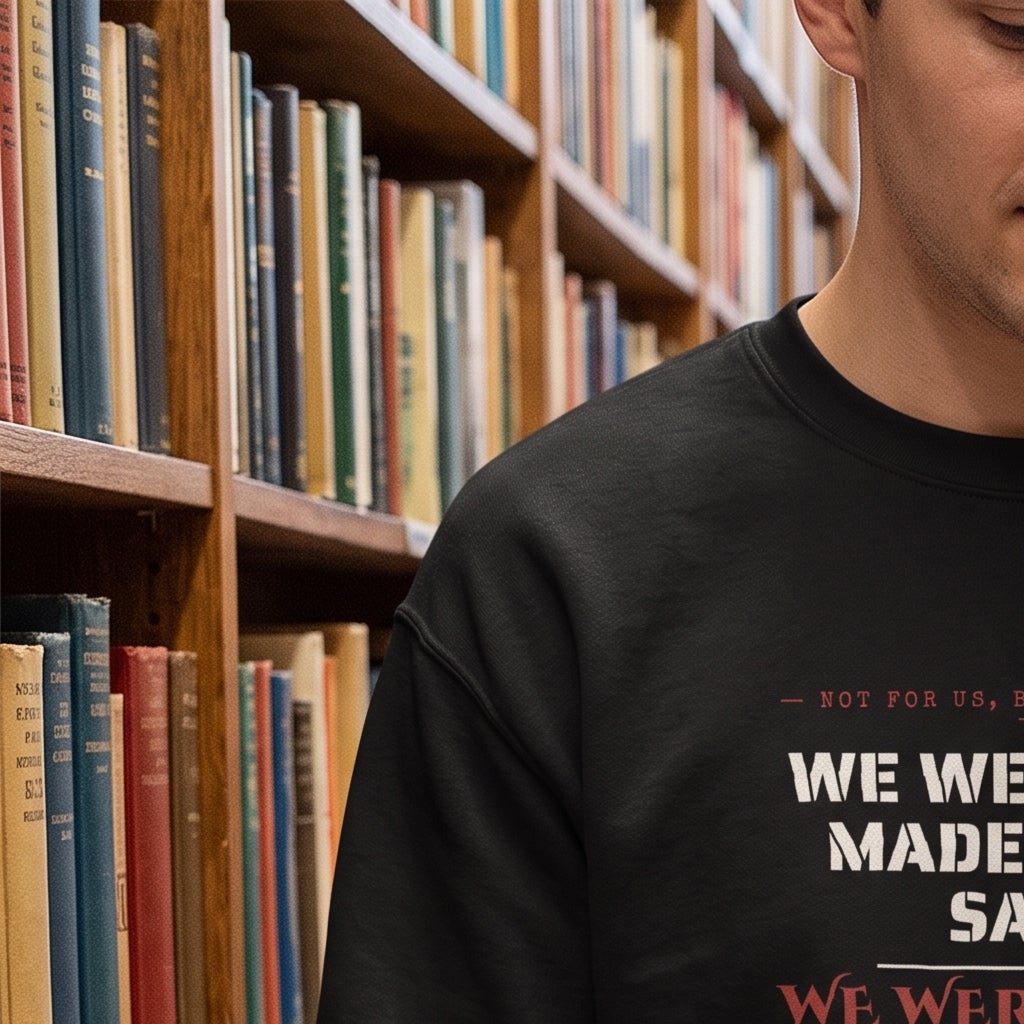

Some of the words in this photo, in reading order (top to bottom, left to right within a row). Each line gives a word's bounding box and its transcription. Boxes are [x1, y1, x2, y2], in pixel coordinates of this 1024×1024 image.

[820, 690, 870, 709] NOT
[887, 690, 937, 708] FOR
[953, 690, 997, 711] US,
[787, 751, 899, 804] WE
[828, 821, 1024, 874] MADE
